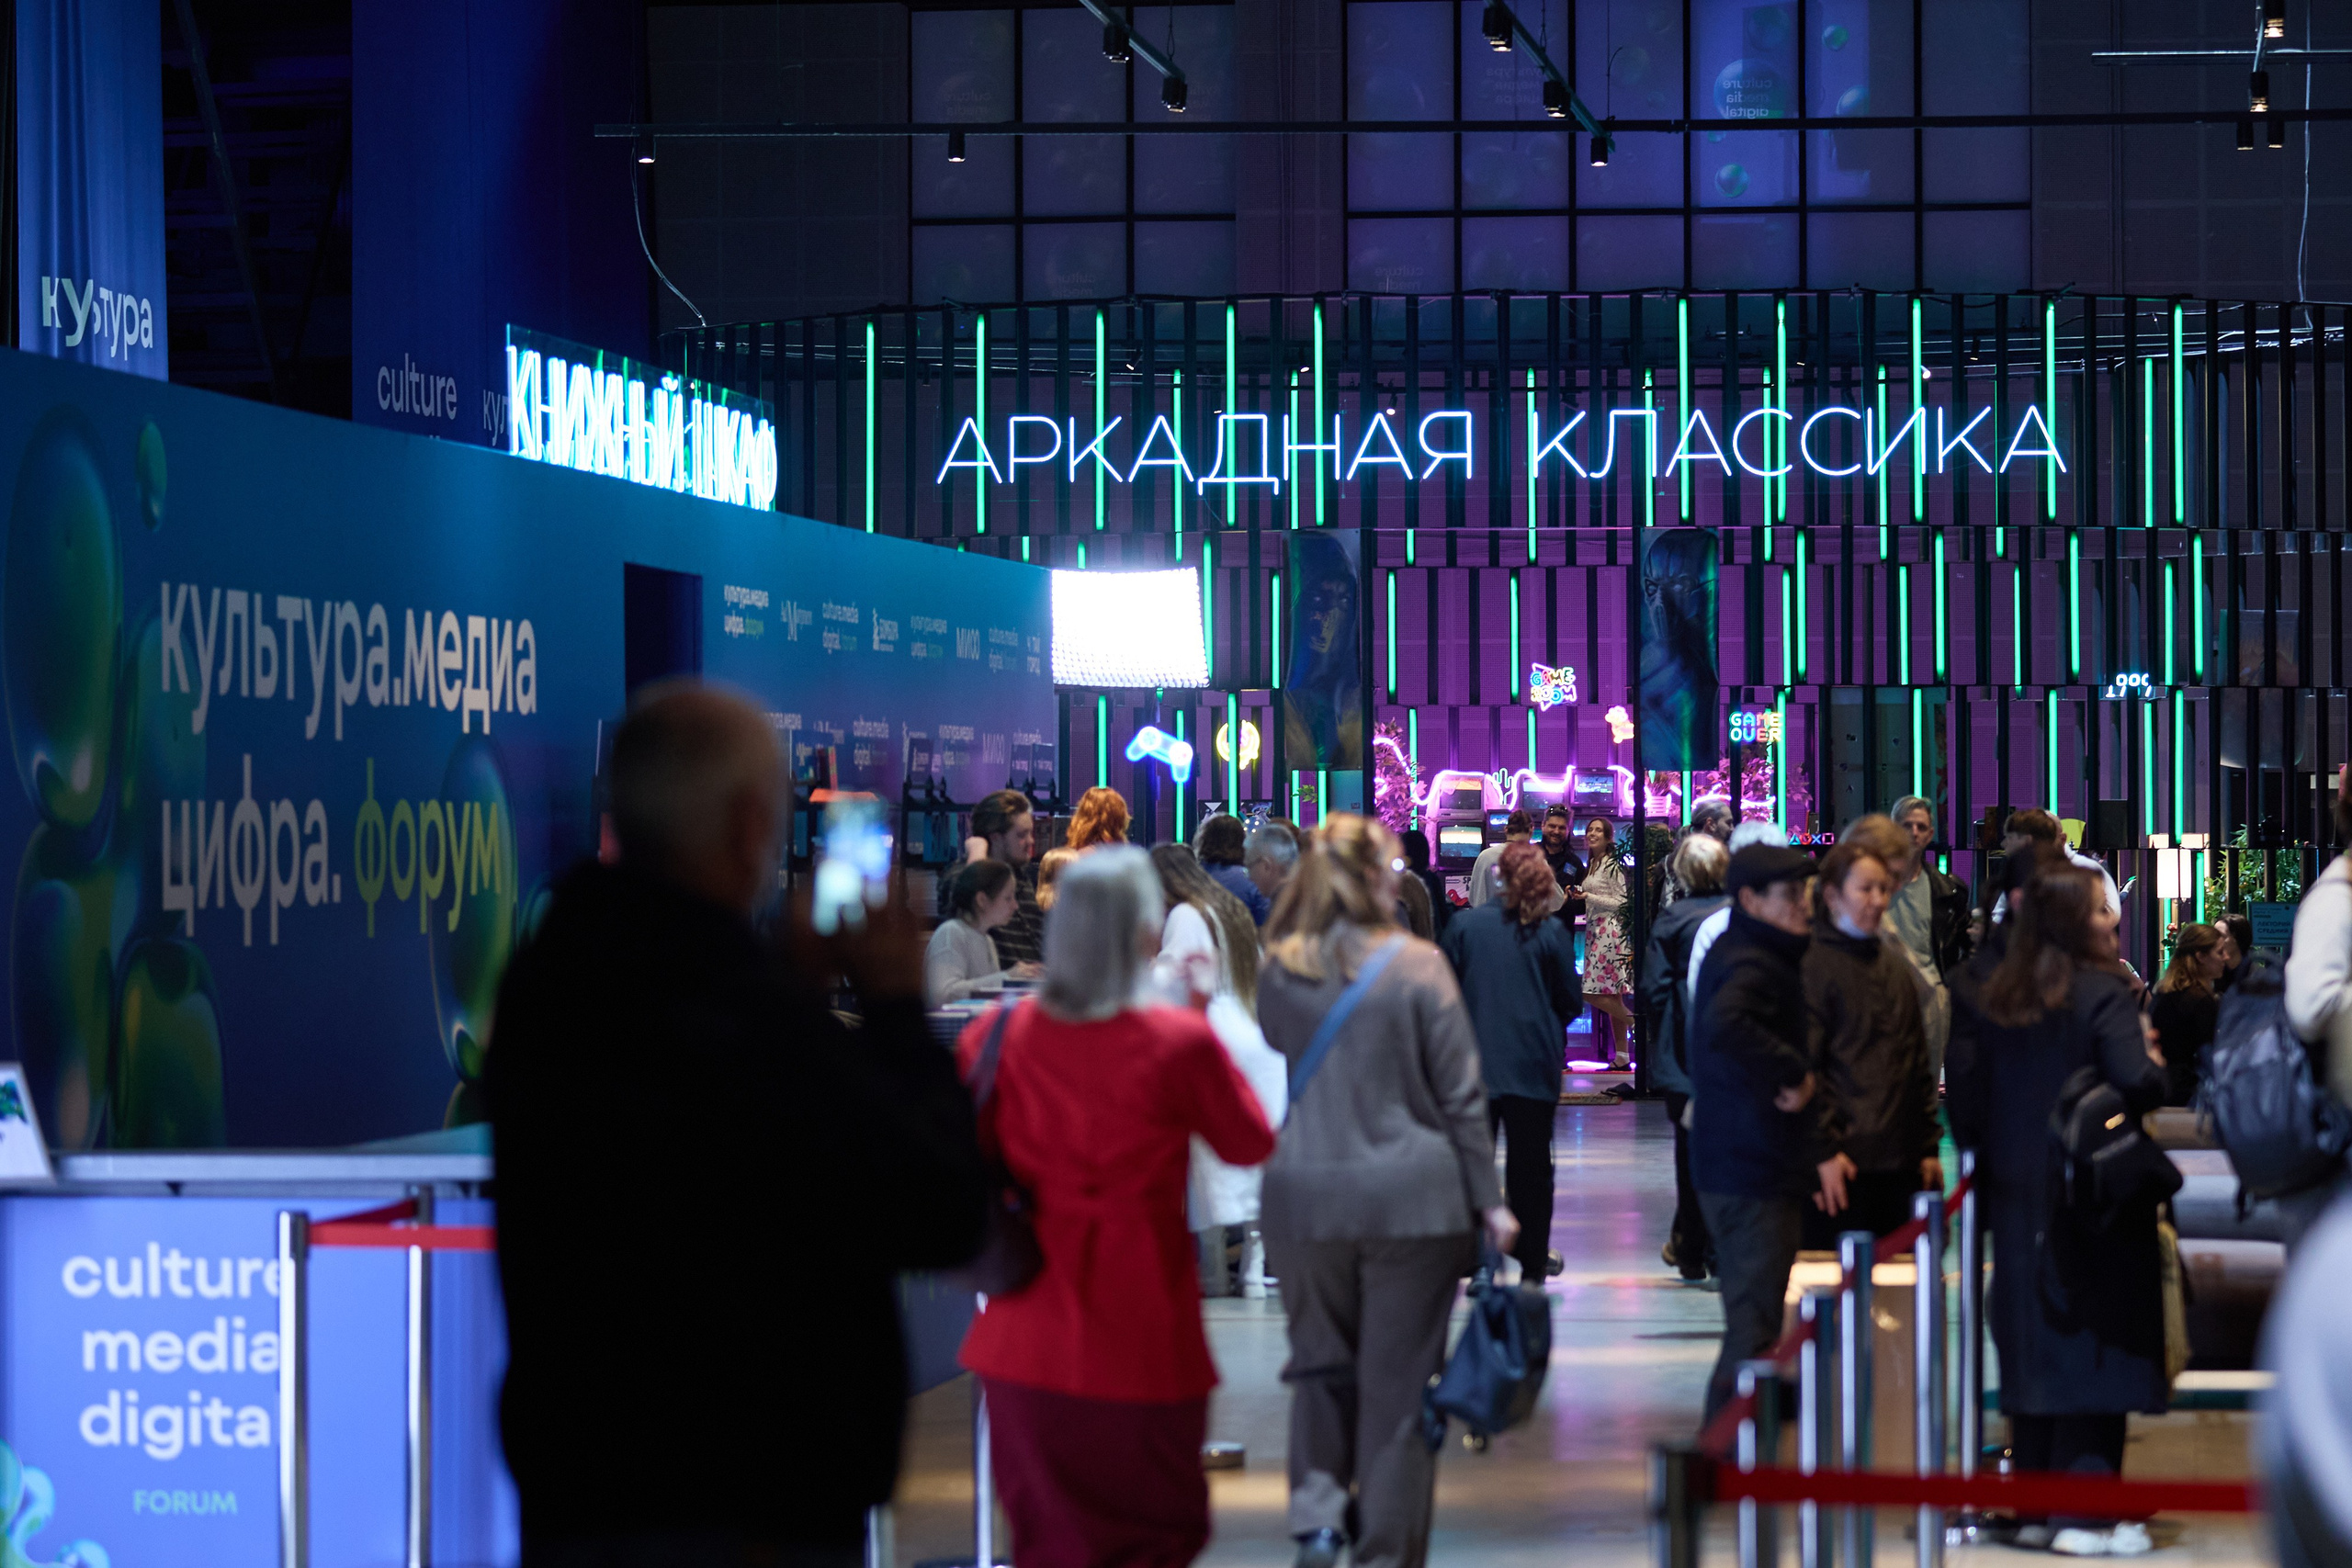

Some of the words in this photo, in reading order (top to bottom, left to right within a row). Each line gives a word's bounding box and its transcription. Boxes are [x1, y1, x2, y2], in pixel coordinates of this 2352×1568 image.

[378, 352, 458, 421] culture
[506, 344, 685, 493] КНИЖНЫЙ
[691, 398, 778, 512] ШКАФ
[936, 411, 1473, 496] АРКАДНАЯ
[1532, 404, 2068, 479] КЛАССИКА
[160, 581, 538, 742] культура.медиа
[1728, 711, 1782, 727] GAME
[1728, 727, 1782, 743] OVER
[161, 753, 342, 947] цифра.
[354, 756, 502, 938] форум
[82, 1314, 281, 1374] media
[78, 1389, 272, 1461] digita
[132, 1489, 239, 1516] FORUM
